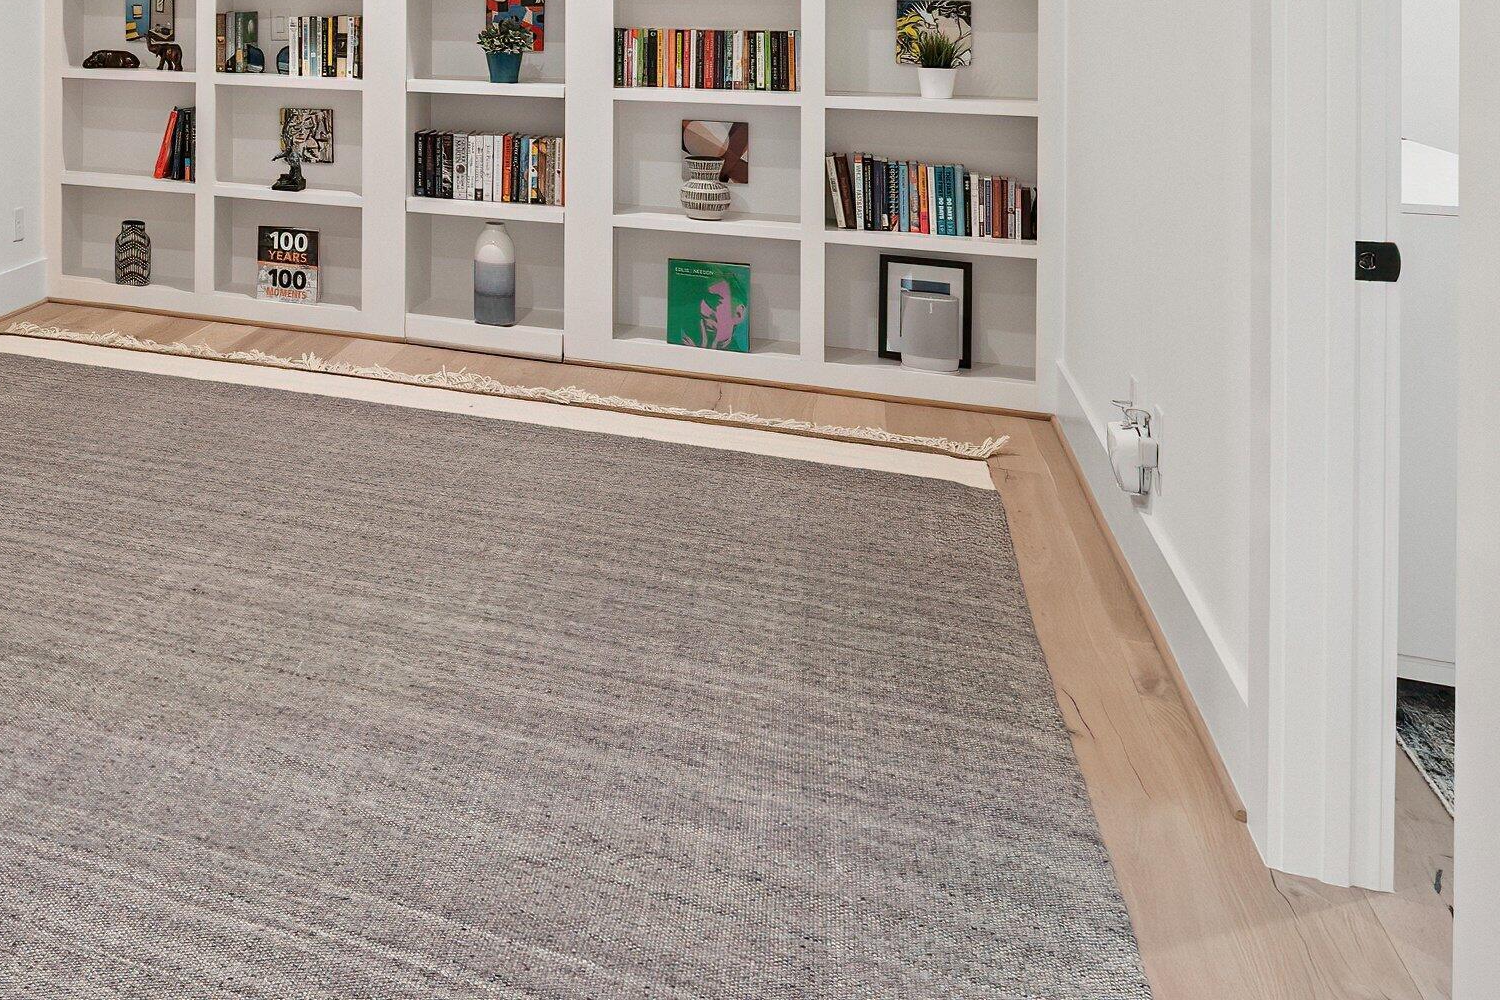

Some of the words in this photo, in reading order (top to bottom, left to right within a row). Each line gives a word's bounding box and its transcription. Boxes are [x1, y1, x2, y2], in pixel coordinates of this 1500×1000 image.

[269, 231, 308, 252] 100
[268, 250, 308, 263] YEARS
[267, 268, 307, 290] 100
[266, 287, 308, 299] MOMENTS
